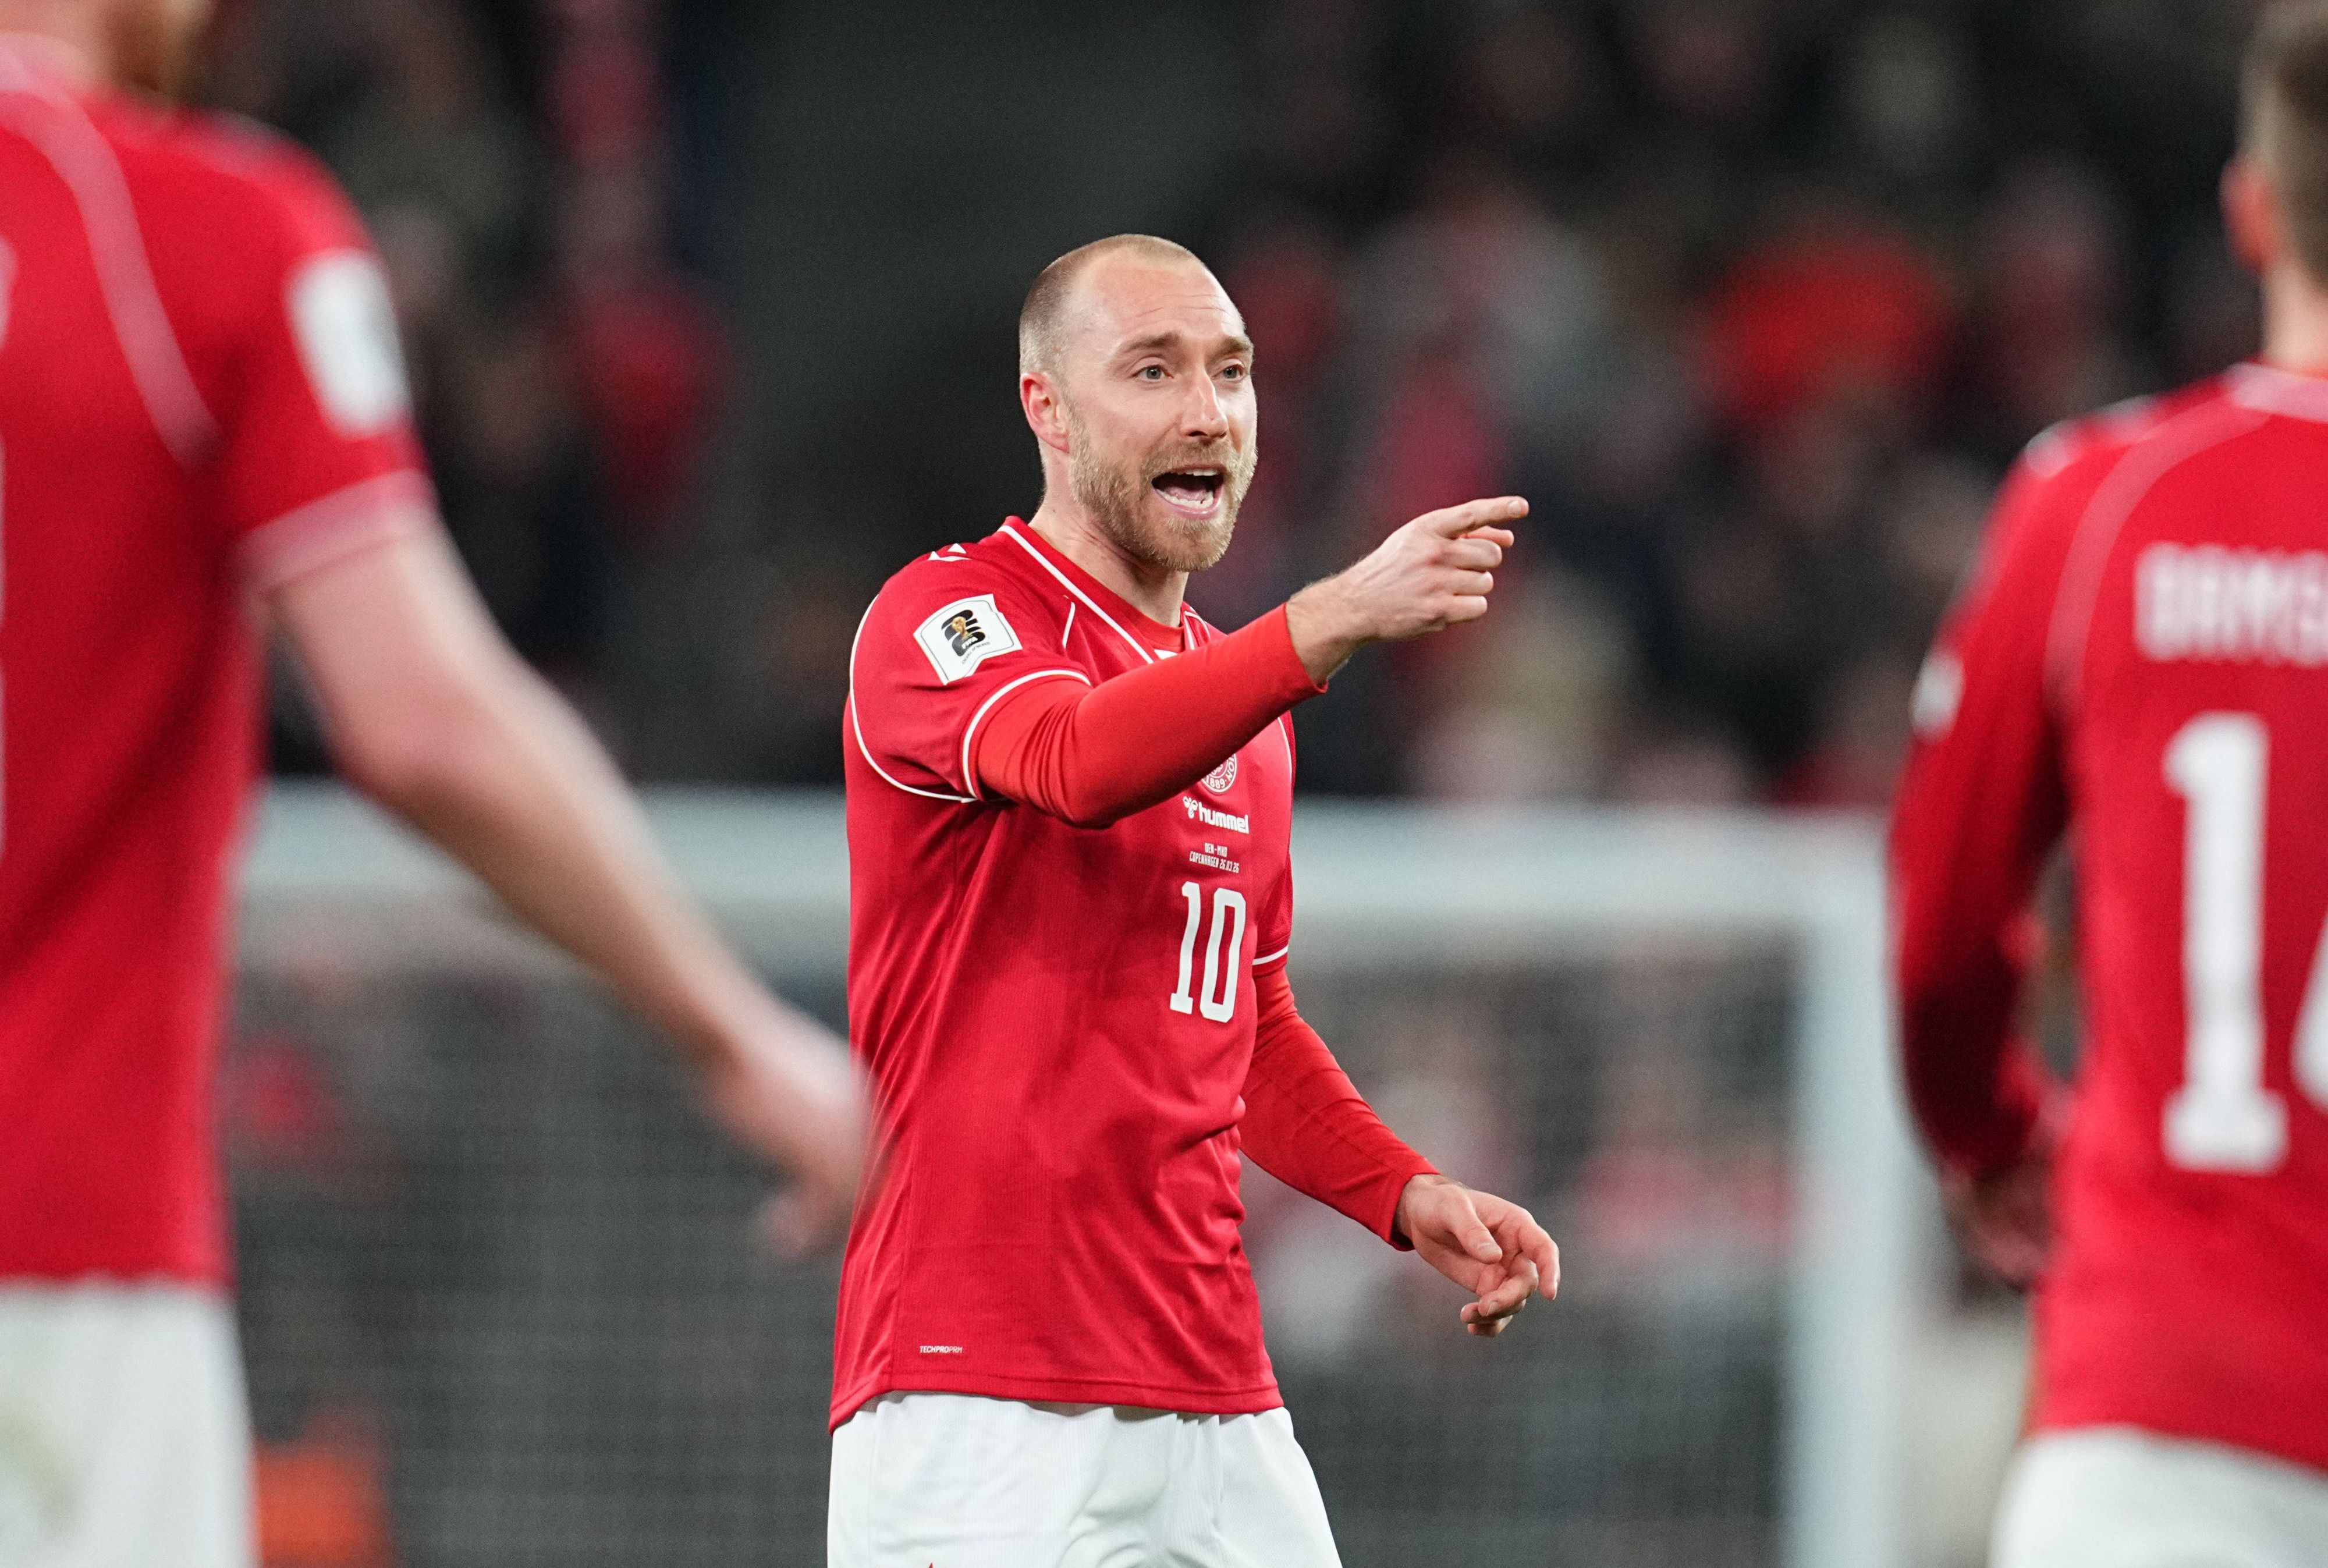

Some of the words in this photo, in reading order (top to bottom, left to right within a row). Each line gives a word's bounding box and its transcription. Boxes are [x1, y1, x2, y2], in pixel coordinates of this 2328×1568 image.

[1206, 775, 1226, 789] 1889
[1198, 801, 1250, 835] hummel
[1189, 850, 1219, 868] COPENHAGEN
[1170, 881, 1247, 1023] 10
